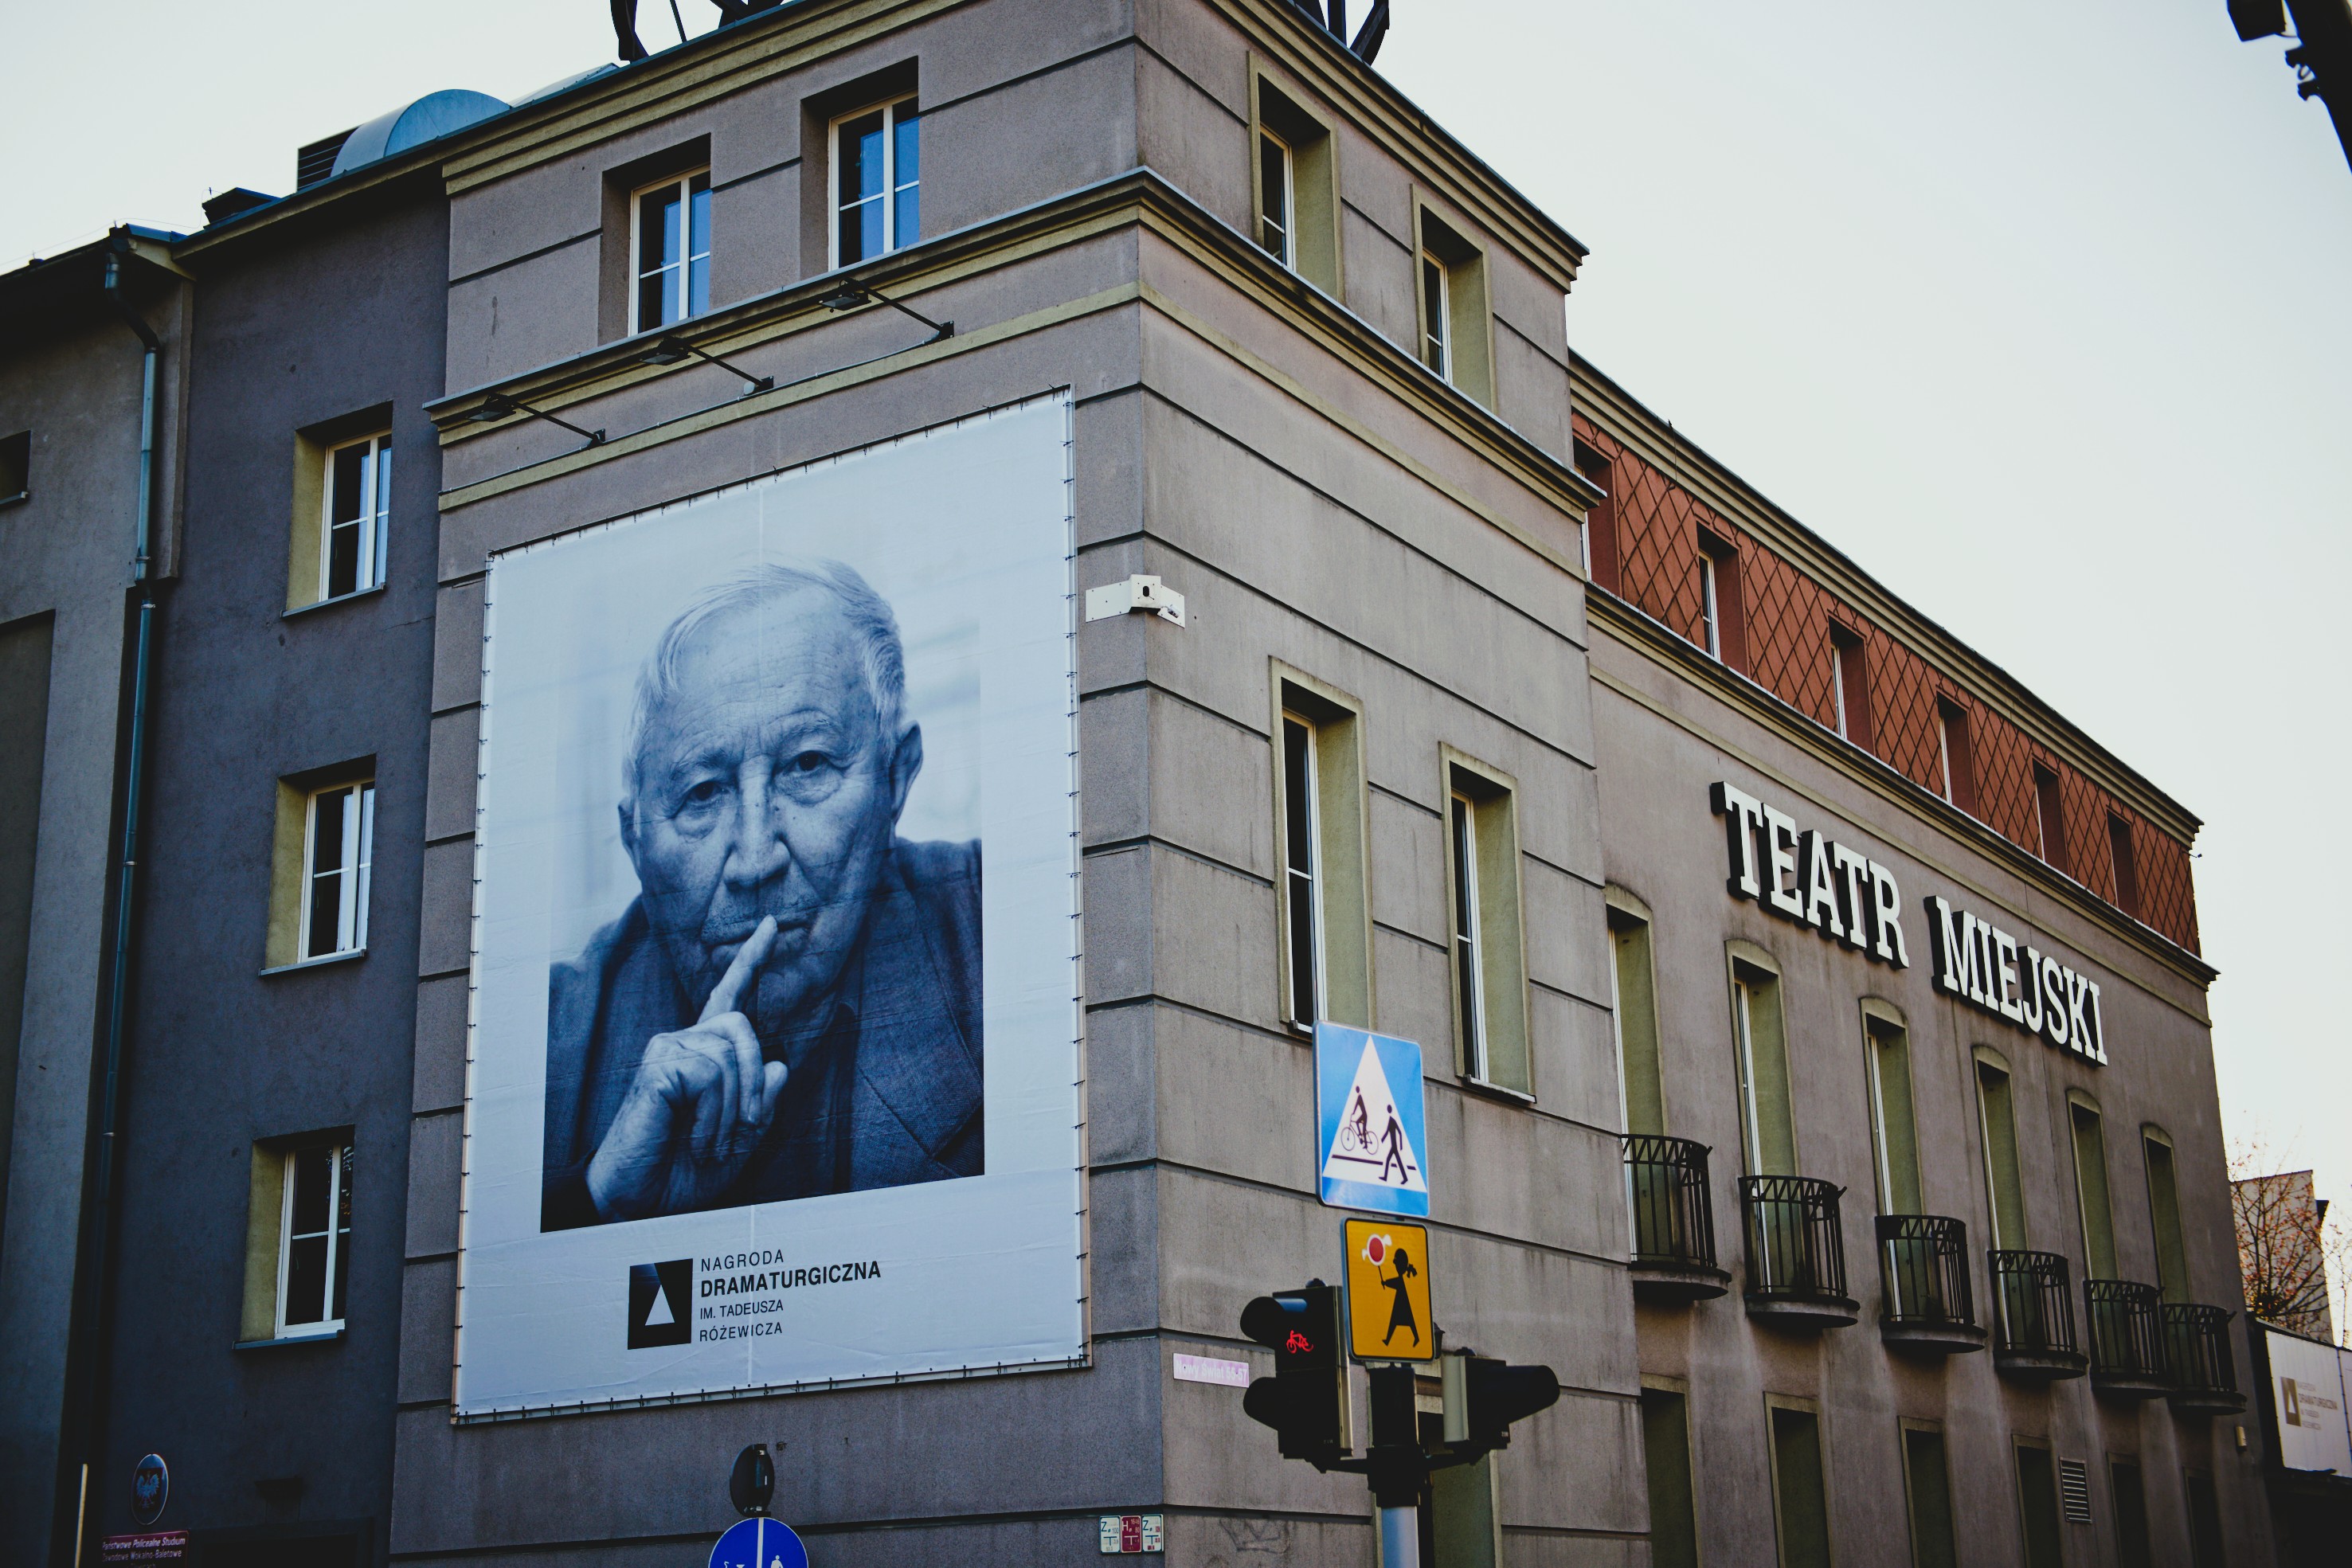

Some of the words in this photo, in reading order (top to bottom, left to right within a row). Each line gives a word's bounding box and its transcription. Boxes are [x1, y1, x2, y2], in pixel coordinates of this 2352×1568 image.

[1715, 780, 1909, 969] TEATR
[1931, 894, 2107, 1066] MIEJSKI
[701, 1249, 785, 1272] NAGRODA
[701, 1261, 882, 1298] DRAMATURGICZNA
[700, 1308, 716, 1320] IM.
[719, 1299, 784, 1317] TADEUSZA
[699, 1322, 783, 1342] RÓŻEWICZA
[132, 1539, 161, 1548] Policealne
[162, 1536, 186, 1546] Studium
